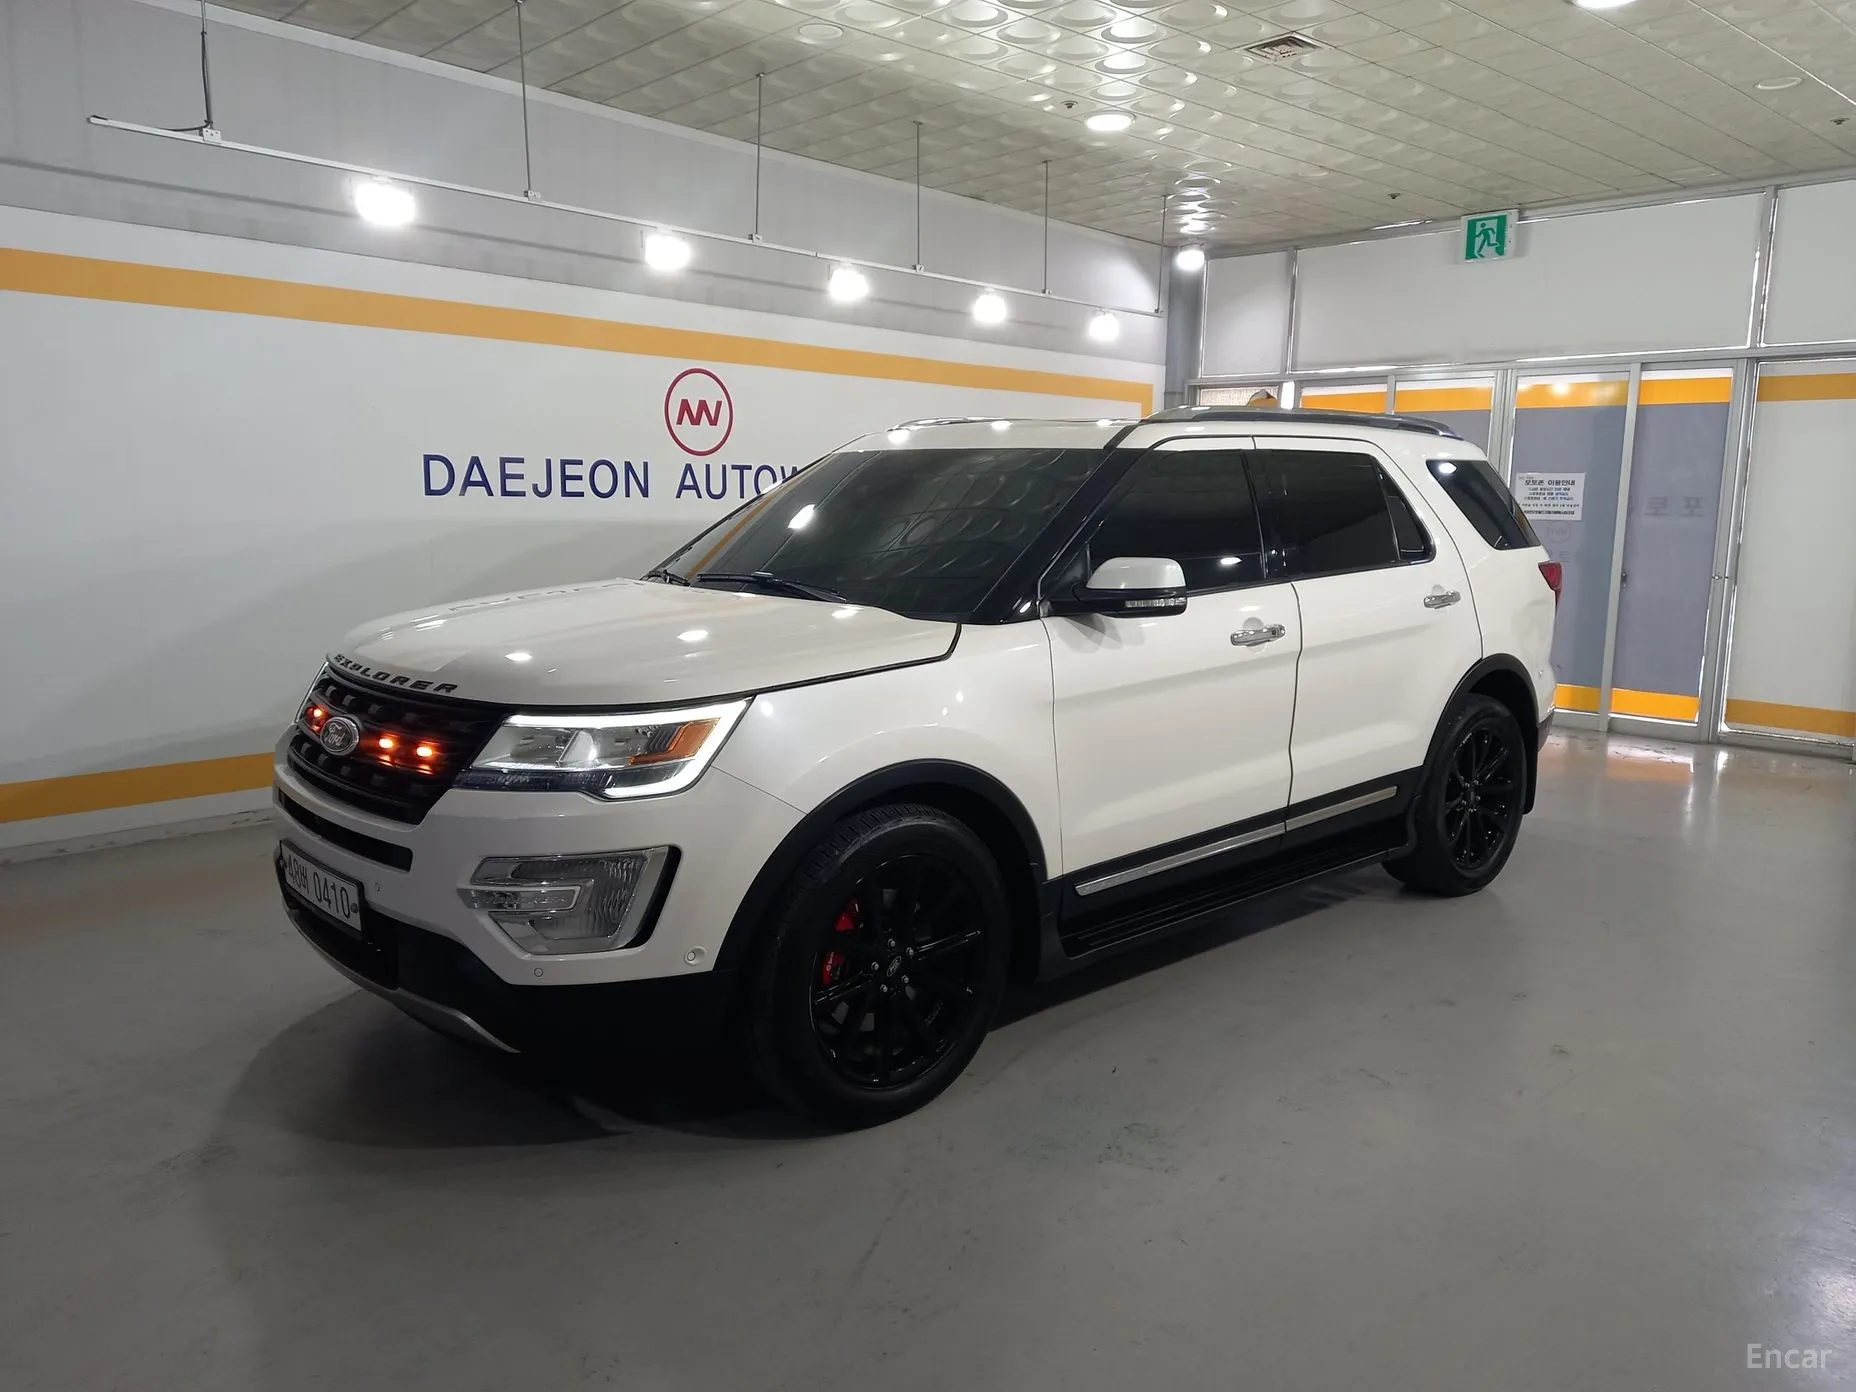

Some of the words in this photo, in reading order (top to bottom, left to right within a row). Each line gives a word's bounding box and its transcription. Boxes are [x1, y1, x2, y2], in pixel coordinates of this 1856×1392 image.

[422, 453, 650, 499] DAEJEON
[675, 462, 798, 500] AUTO
[333, 653, 459, 694] EXPLORER
[312, 871, 351, 920] 0410
